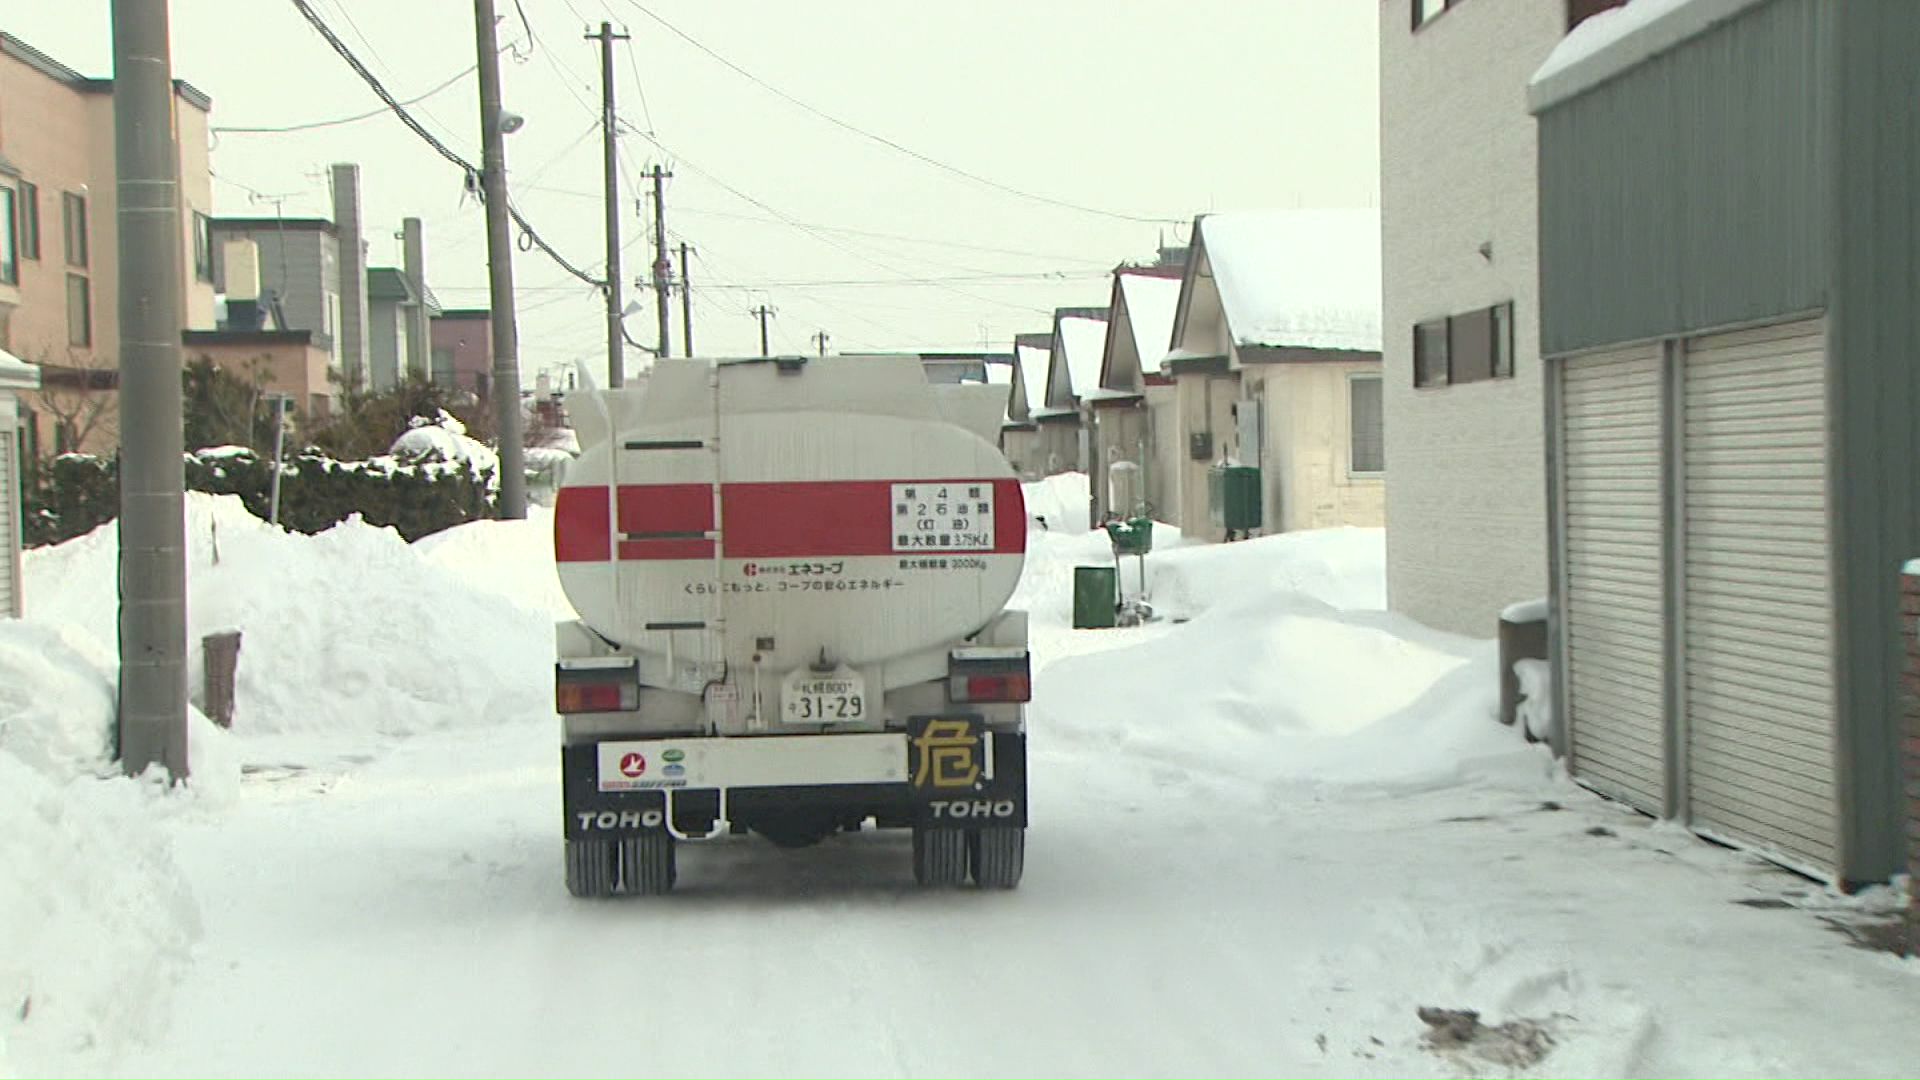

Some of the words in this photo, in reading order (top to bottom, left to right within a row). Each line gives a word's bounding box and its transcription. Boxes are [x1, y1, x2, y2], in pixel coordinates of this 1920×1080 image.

[788, 561, 844, 576] エネコープ
[800, 696, 861, 718] 31-29
[914, 719, 979, 788] 危
[930, 801, 1015, 818] TOHO
[577, 811, 663, 831] TOHO
